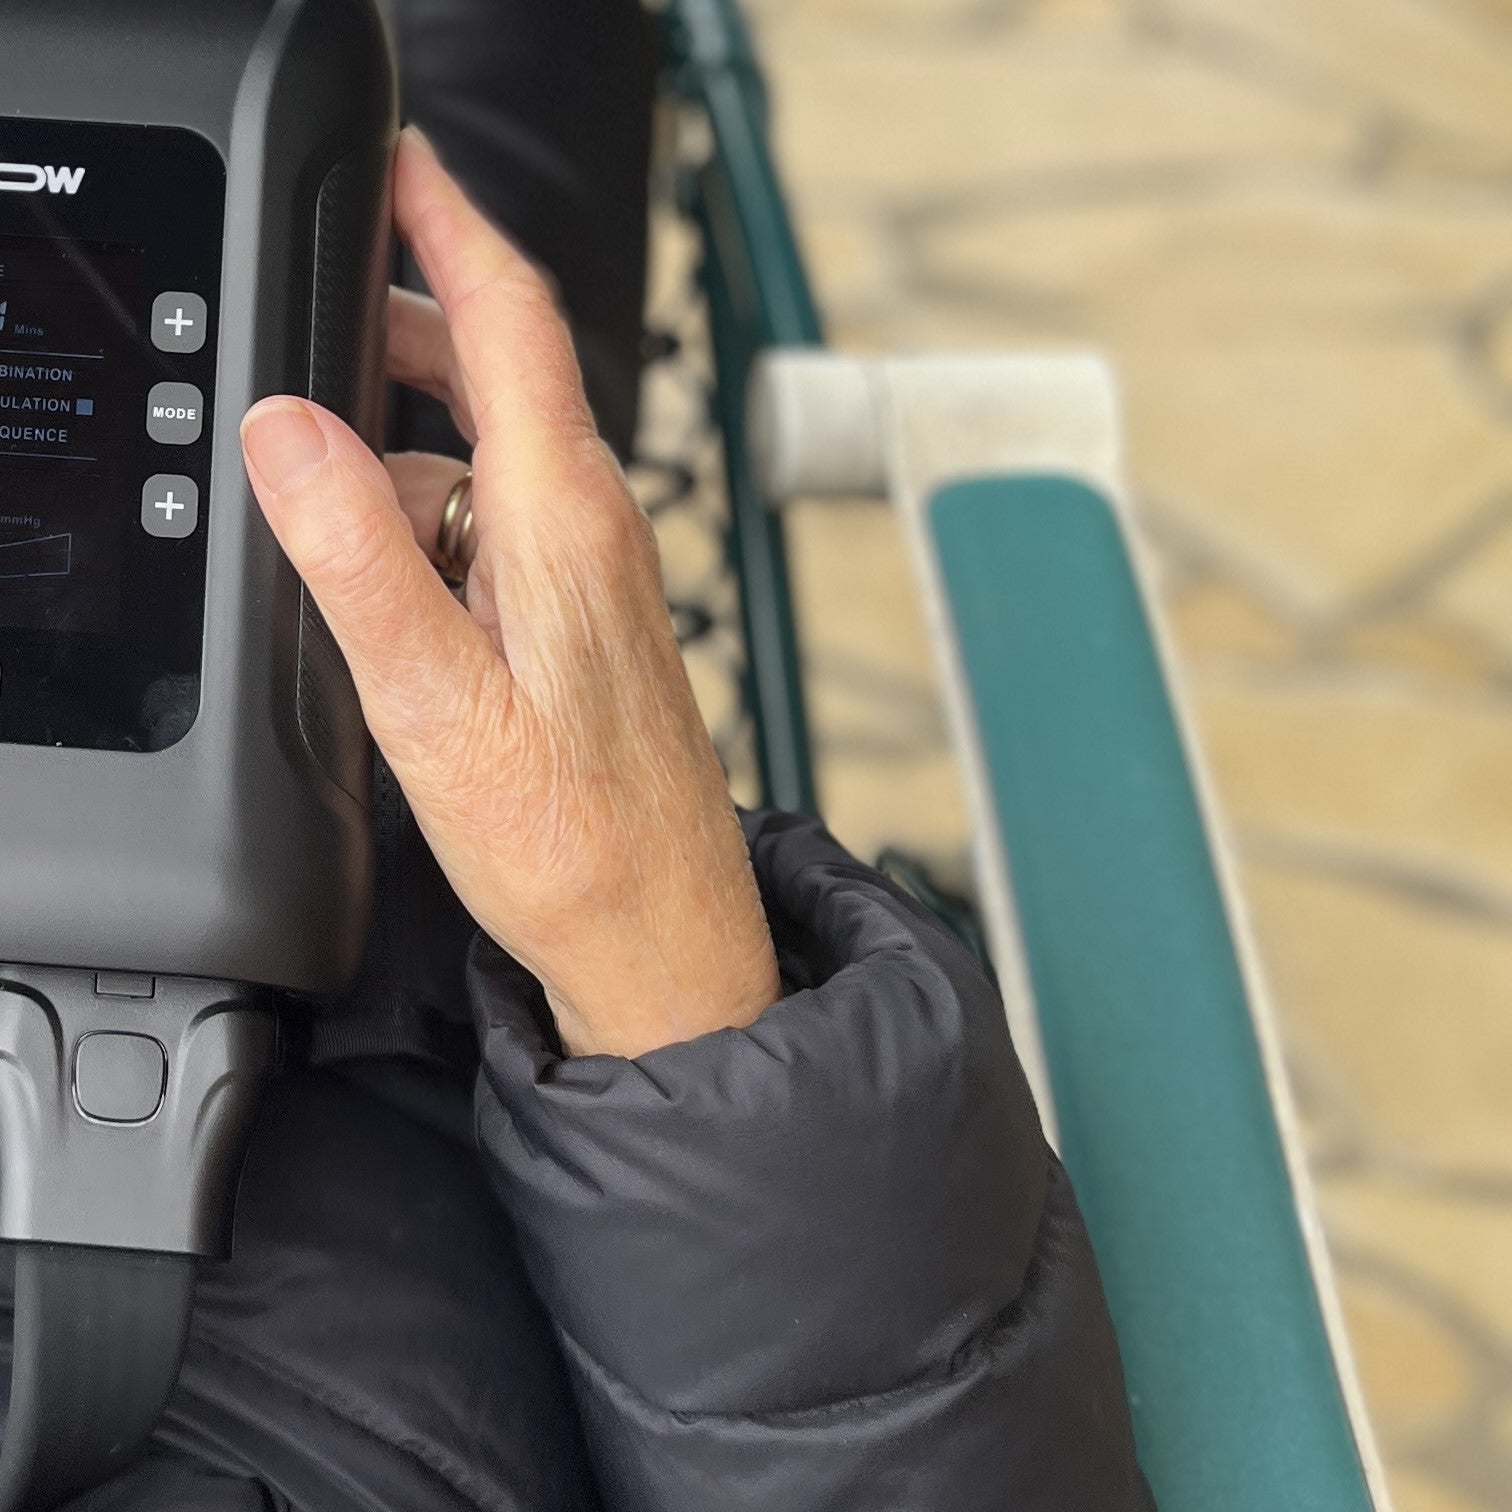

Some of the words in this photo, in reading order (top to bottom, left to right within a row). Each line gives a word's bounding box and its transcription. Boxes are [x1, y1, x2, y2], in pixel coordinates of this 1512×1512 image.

[14, 323, 44, 336] Mins
[152, 406, 197, 421] MODE
[0, 514, 41, 528] mmHg
